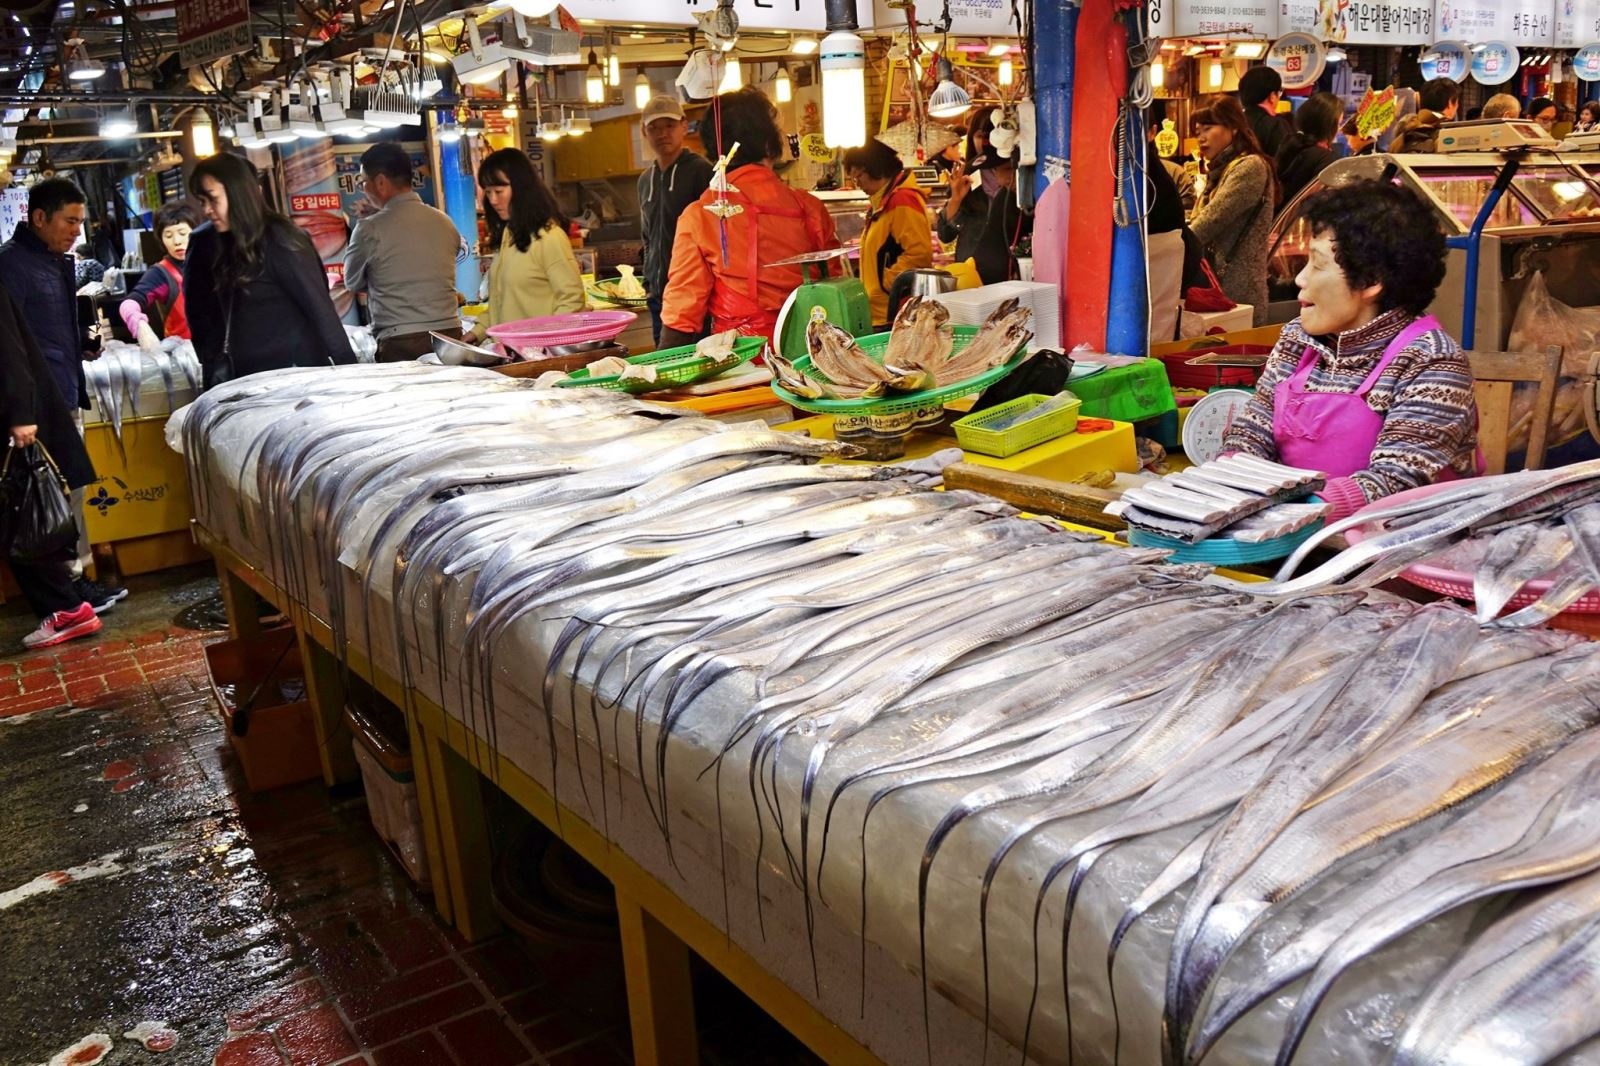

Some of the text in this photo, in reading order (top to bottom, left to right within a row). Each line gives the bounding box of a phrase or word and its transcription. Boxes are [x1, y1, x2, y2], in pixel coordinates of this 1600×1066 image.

[1349, 3, 1432, 35] 해운대활어직매장
[1513, 12, 1548, 37] 화동수산
[1287, 58, 1300, 70] 63
[1438, 62, 1450, 72] 64
[292, 196, 340, 210] 당일바리
[124, 486, 165, 503] 수산시장
